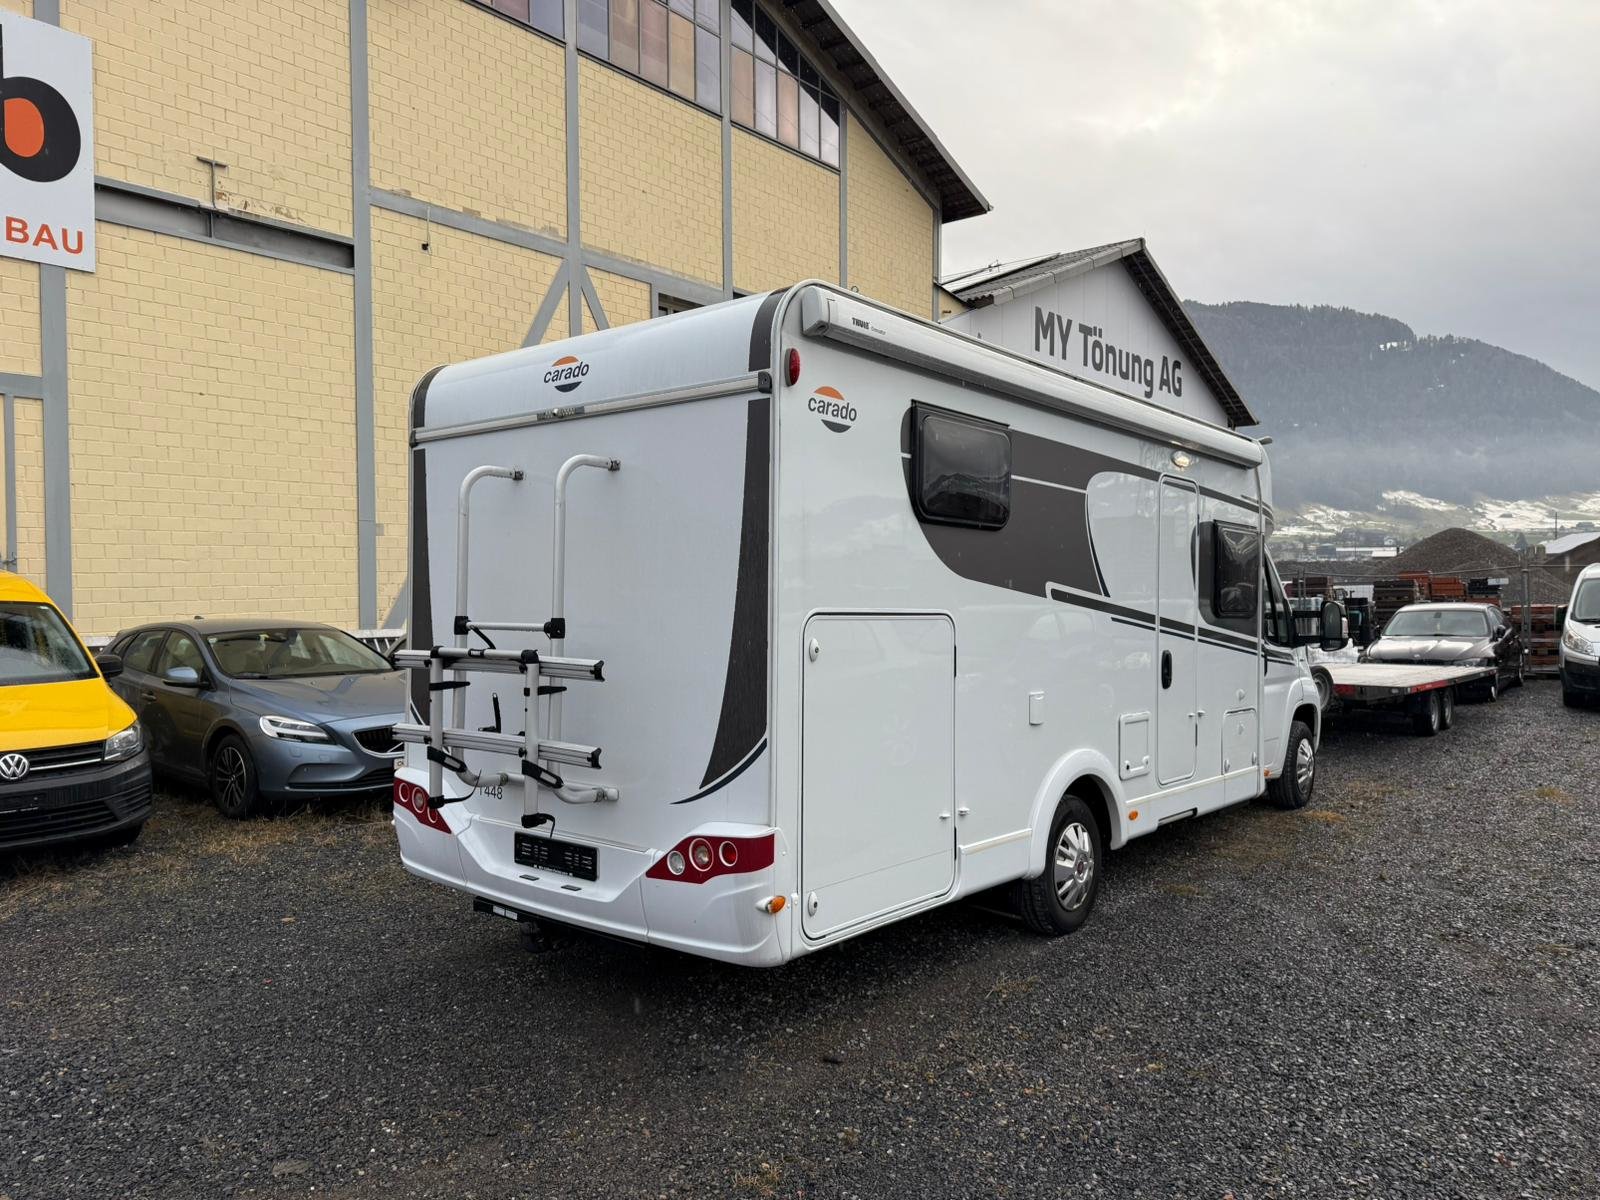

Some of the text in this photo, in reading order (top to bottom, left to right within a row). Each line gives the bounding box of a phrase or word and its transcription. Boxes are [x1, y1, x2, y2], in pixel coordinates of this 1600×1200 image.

[5, 216, 83, 255] BAU
[1034, 306, 1182, 399] MY Tönung AG
[543, 361, 590, 384] carado
[808, 397, 857, 422] carado
